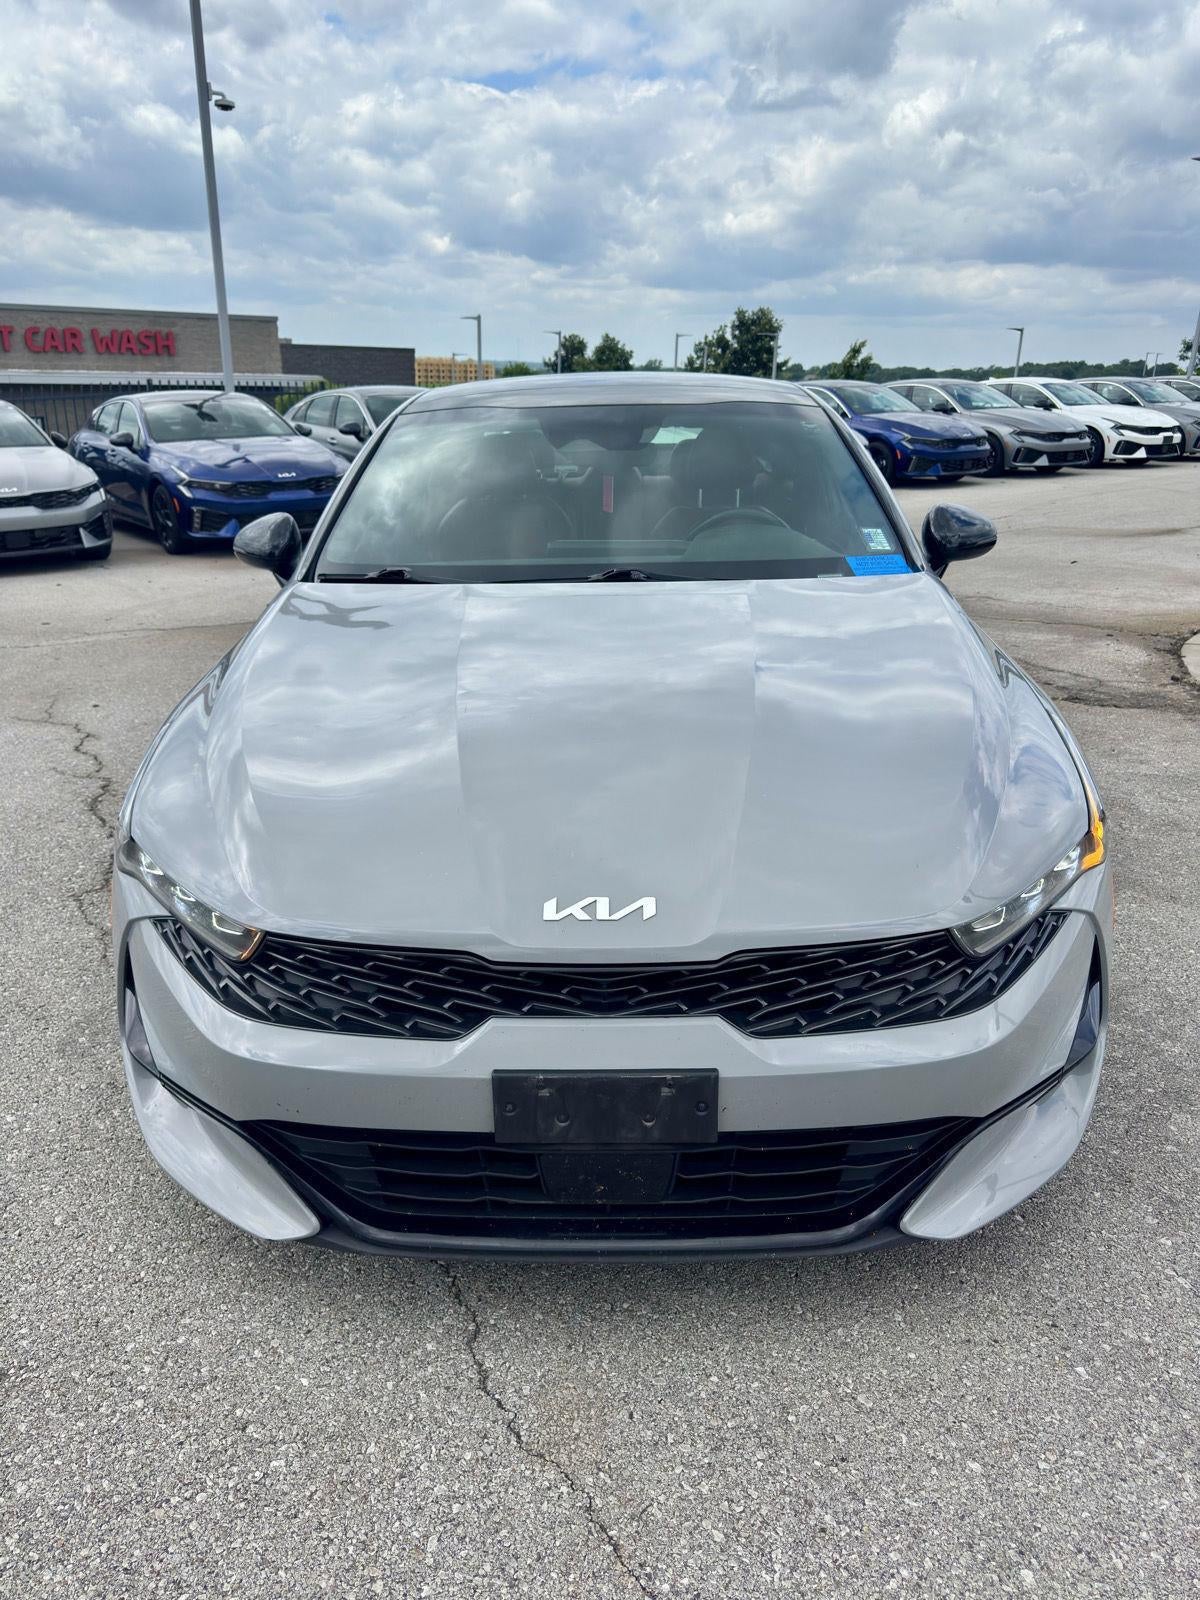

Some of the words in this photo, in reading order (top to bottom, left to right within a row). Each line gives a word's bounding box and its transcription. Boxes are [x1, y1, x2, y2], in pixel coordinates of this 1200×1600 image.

[24, 327, 85, 353] CAR
[91, 328, 176, 356] WASH
[543, 896, 657, 922] KIA
